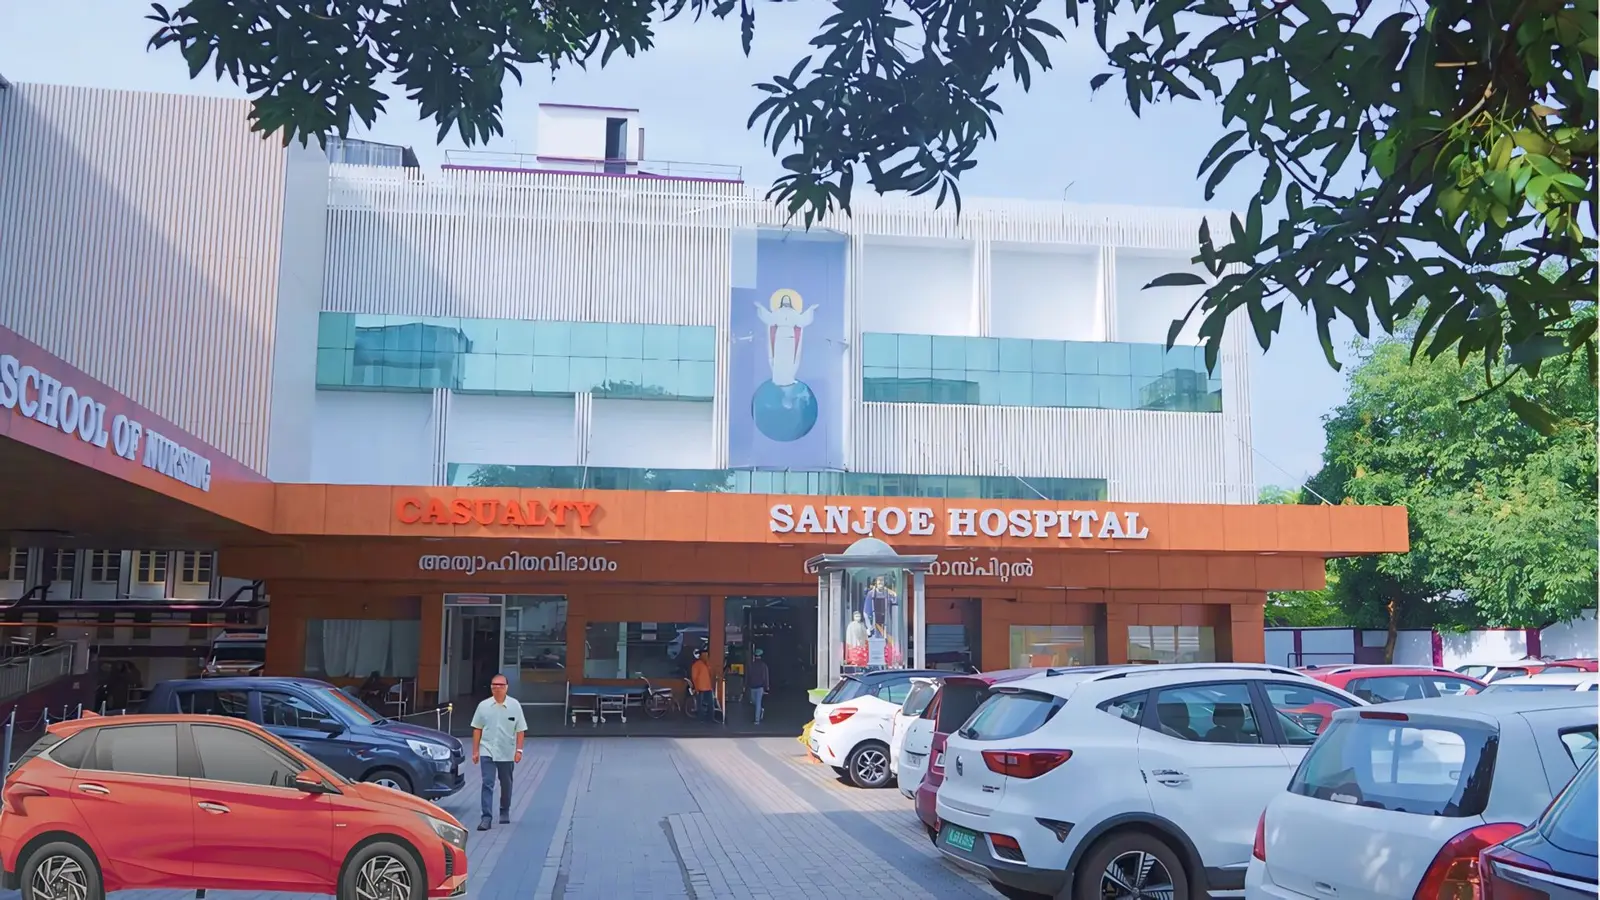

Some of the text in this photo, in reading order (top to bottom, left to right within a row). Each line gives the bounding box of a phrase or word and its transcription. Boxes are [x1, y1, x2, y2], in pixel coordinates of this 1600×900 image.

[0, 354, 211, 492] SCHOOL OF NURSING
[395, 497, 601, 527] CASUALTY
[769, 504, 1149, 540] SANJOE HOSPITAL
[418, 551, 618, 575] അത്യാഹിതവിഭാഗം
